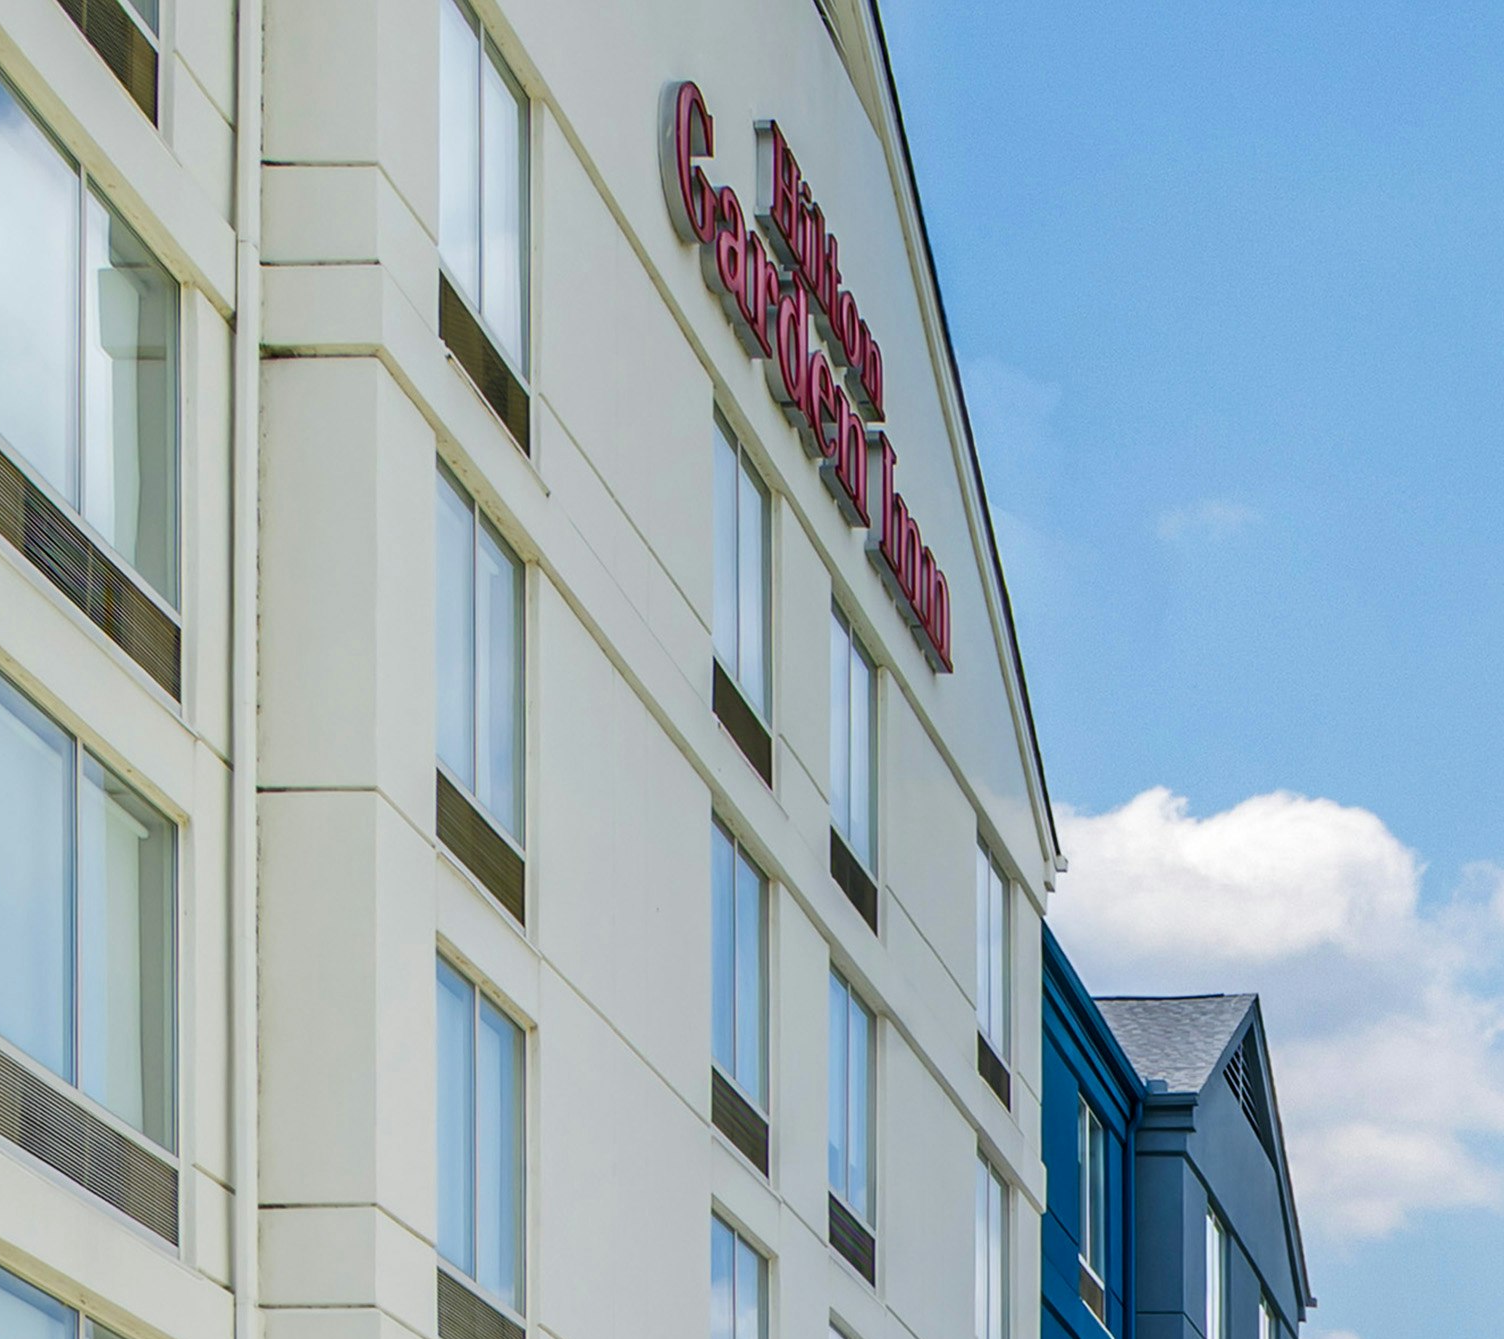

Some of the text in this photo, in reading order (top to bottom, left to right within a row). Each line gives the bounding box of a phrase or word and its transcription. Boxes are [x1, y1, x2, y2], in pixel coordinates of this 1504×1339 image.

[662, 80, 953, 673] Garden Inn
[760, 119, 885, 423] Hilton
